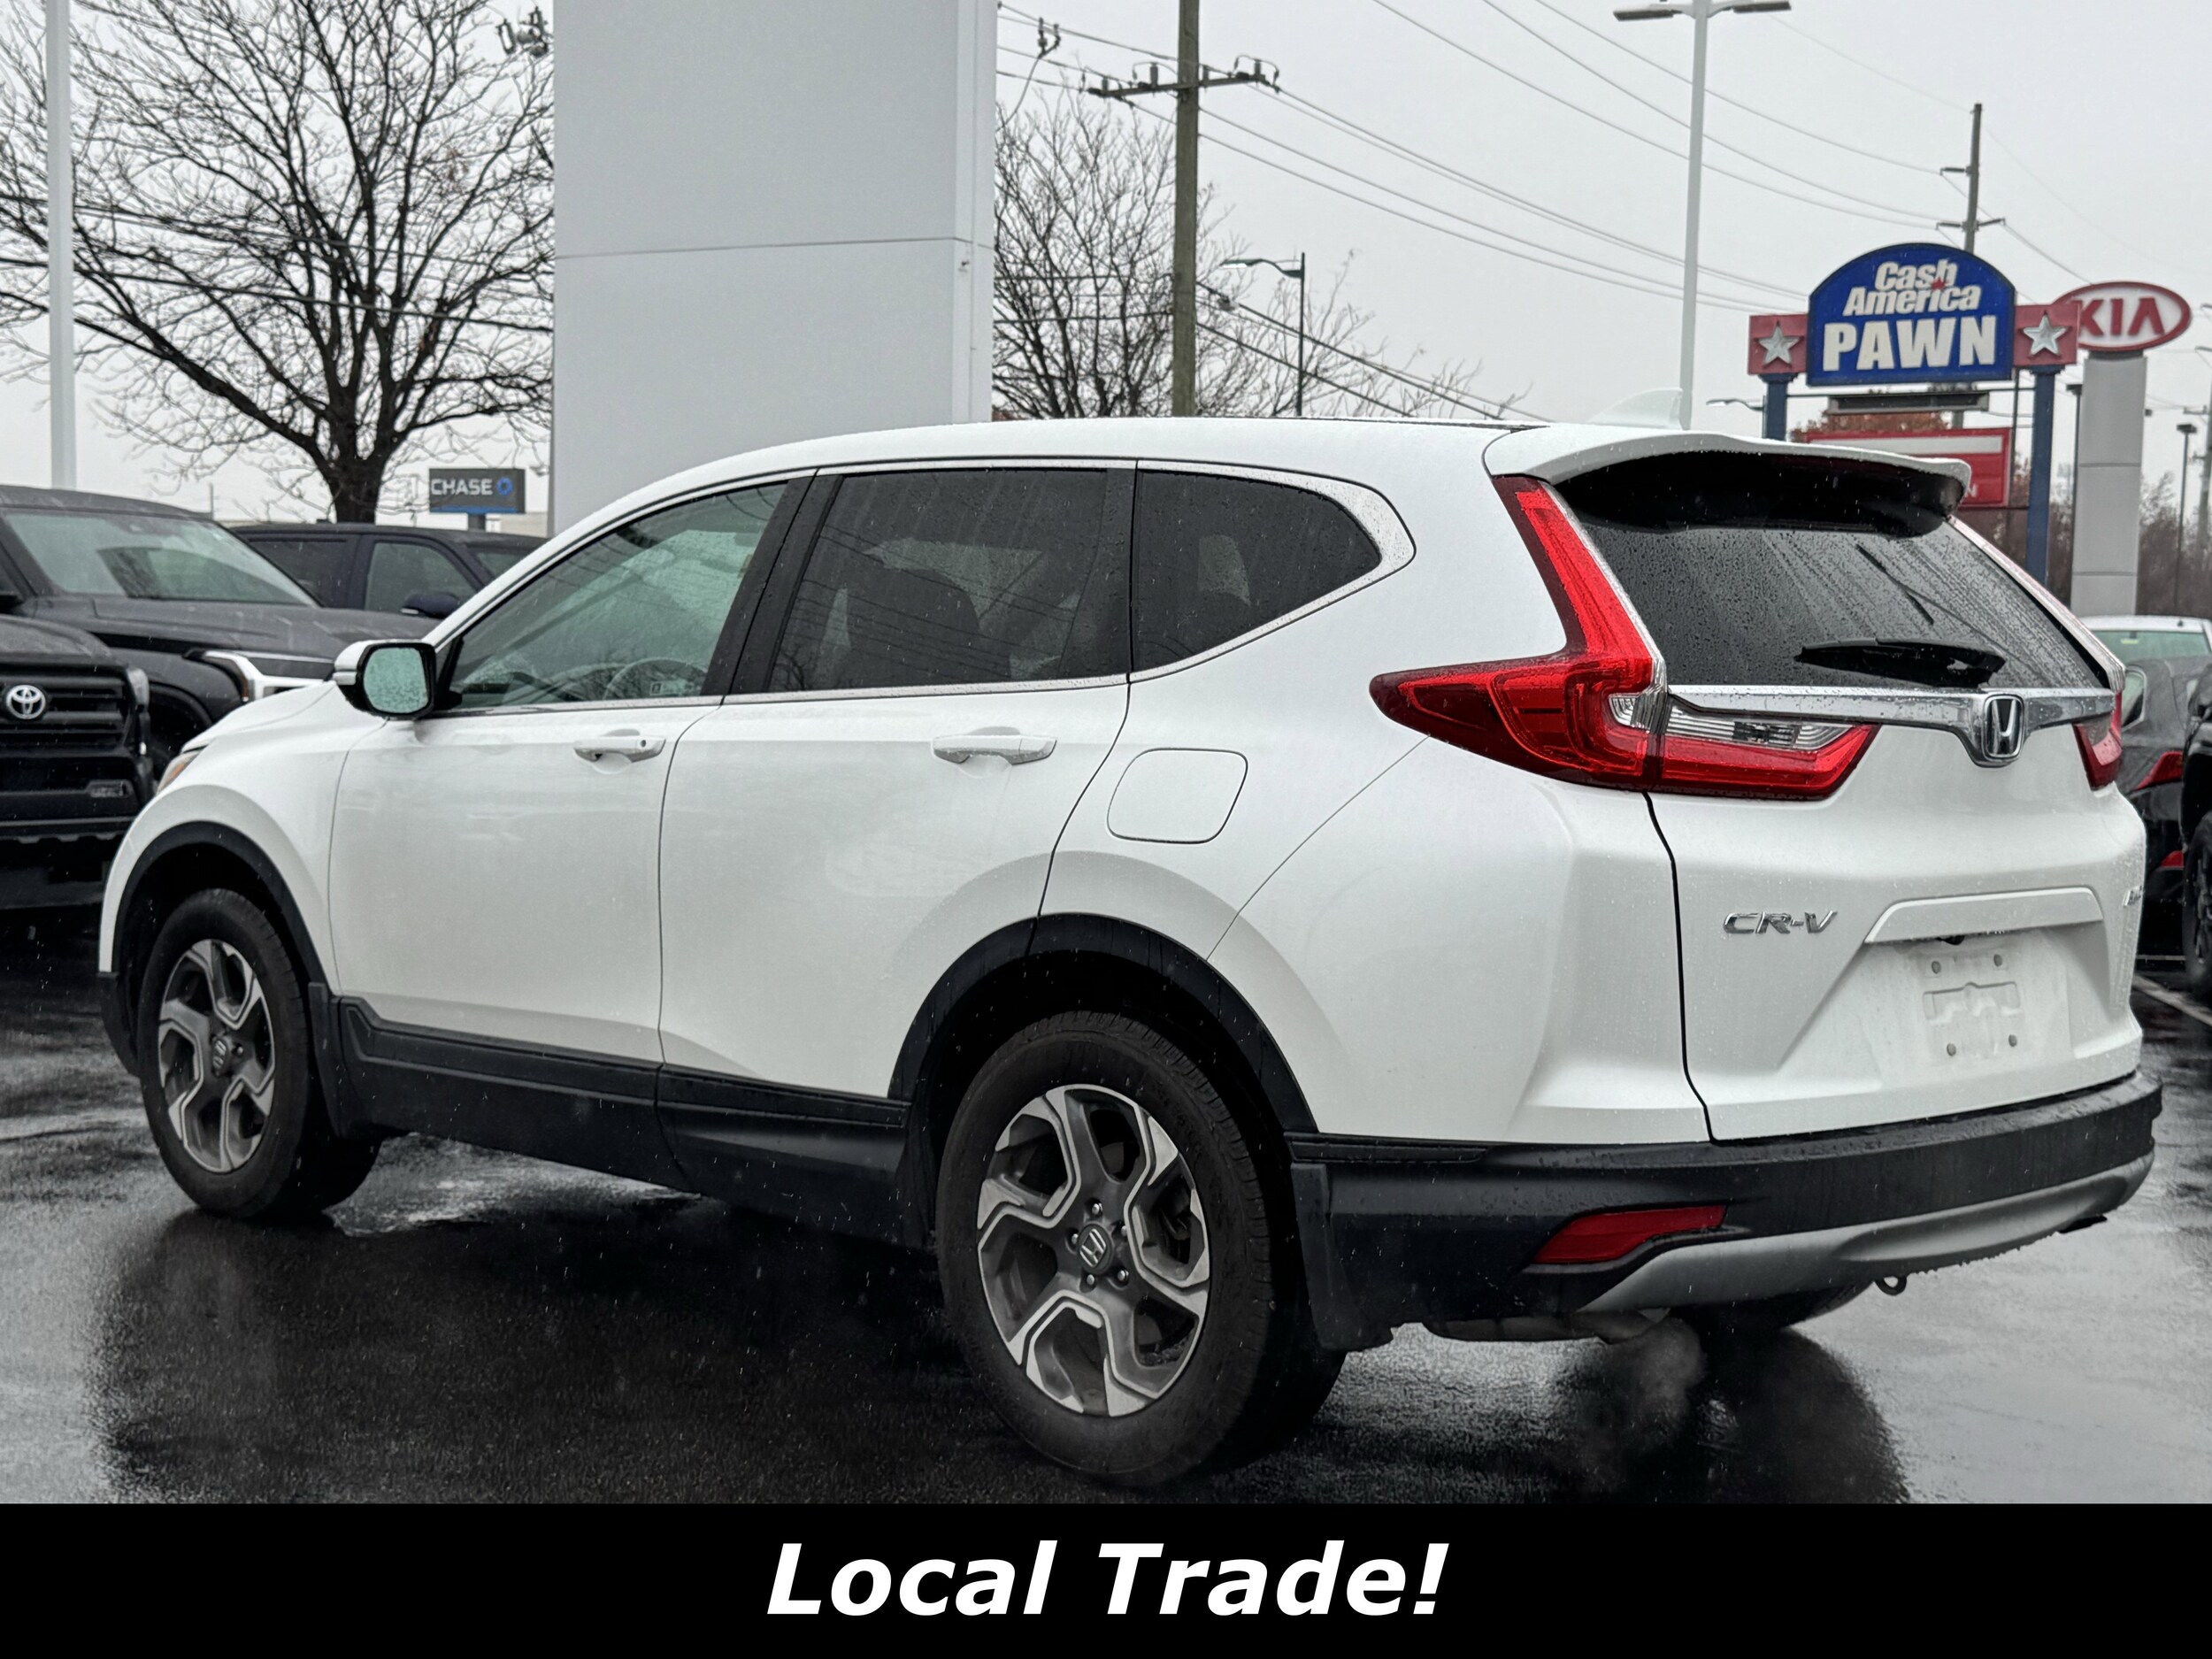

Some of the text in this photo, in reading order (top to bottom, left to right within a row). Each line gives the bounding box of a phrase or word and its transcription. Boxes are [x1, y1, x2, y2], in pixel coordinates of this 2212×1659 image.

[1874, 258, 1958, 292] Cash
[1841, 284, 1982, 317] America
[2077, 297, 2165, 336] KIA
[1823, 314, 1996, 372] PAWN
[430, 479, 493, 495] CHASE
[1723, 910, 1838, 934] CR-V
